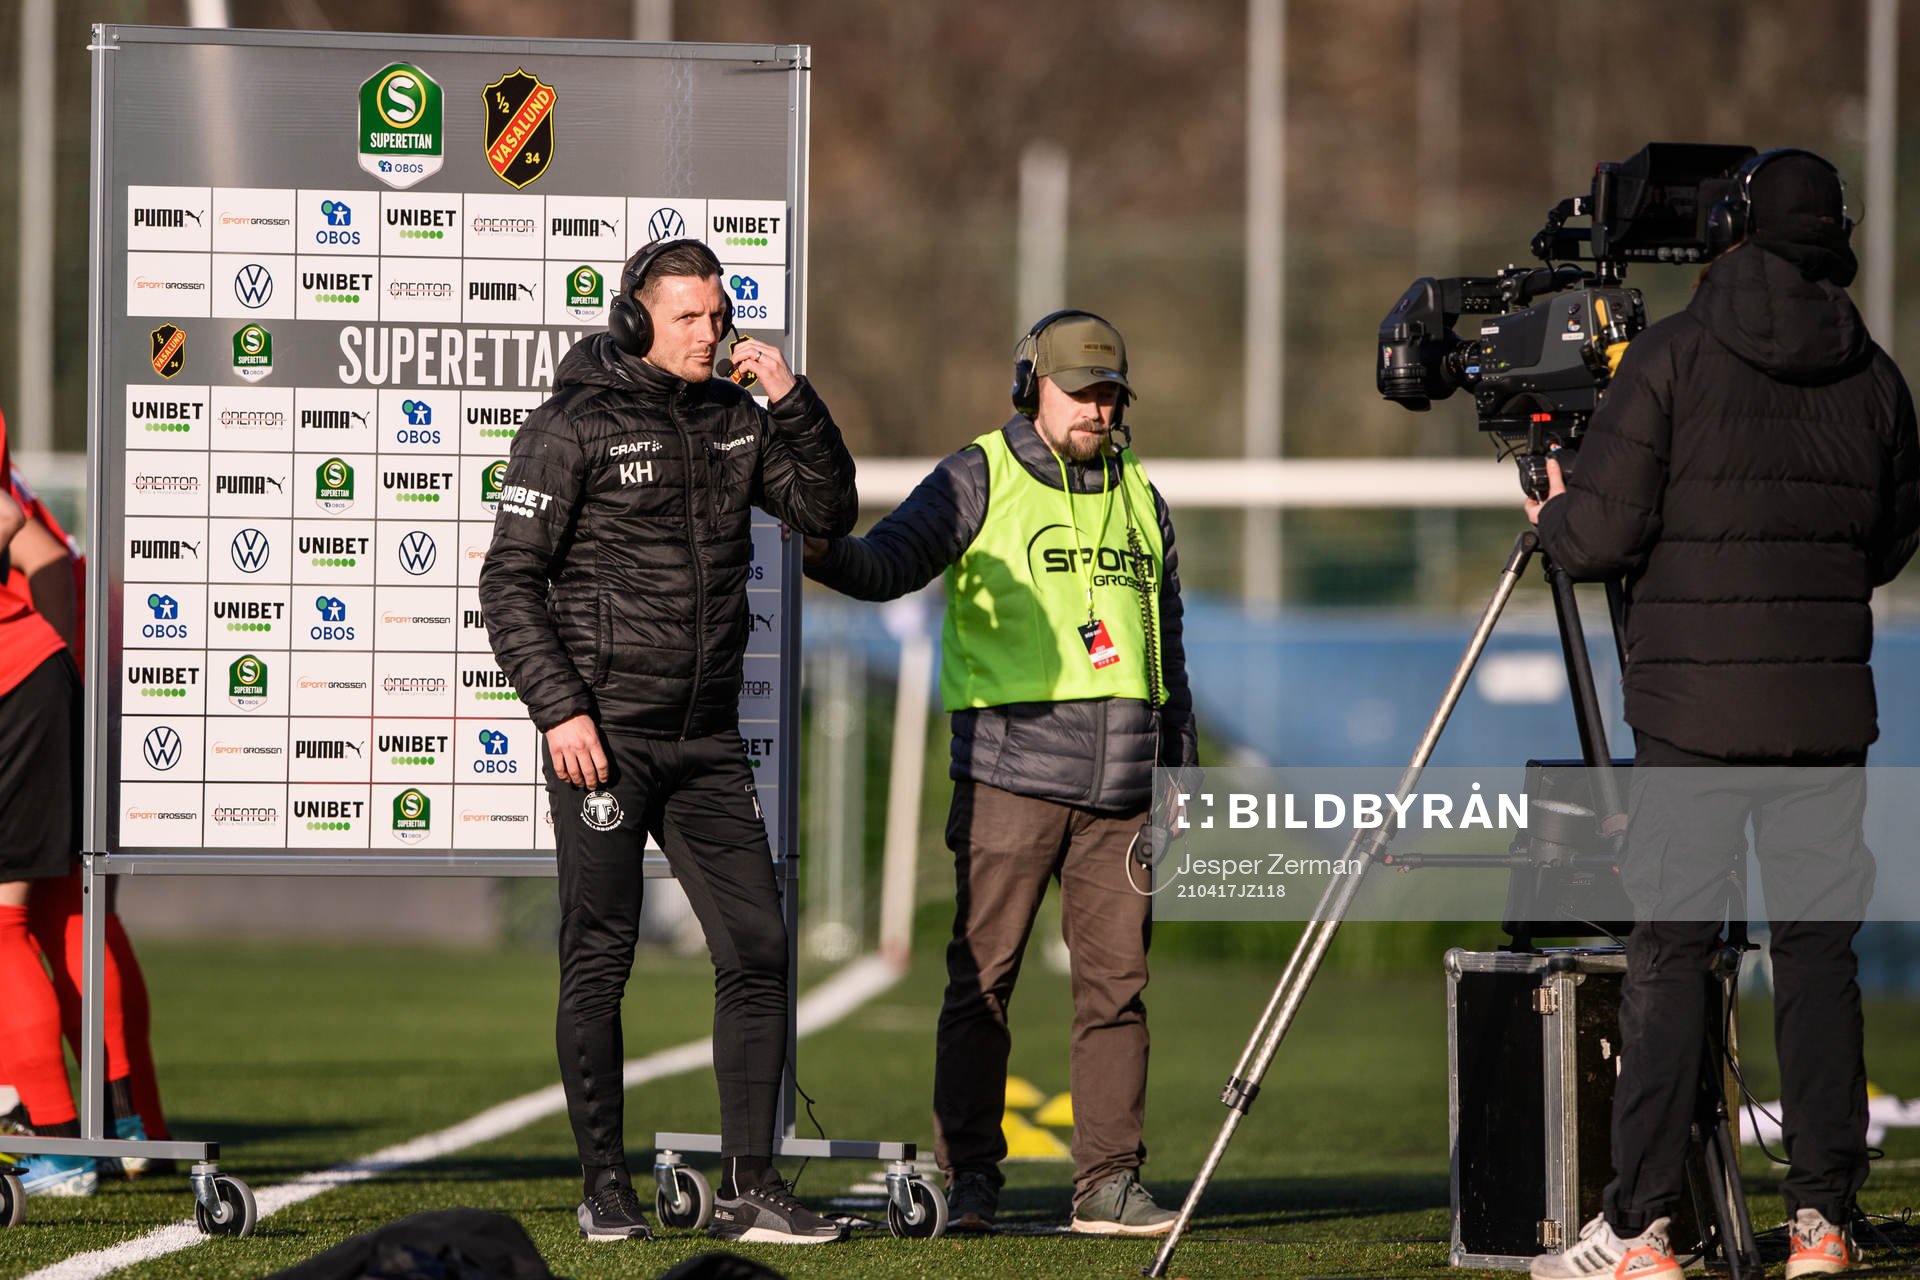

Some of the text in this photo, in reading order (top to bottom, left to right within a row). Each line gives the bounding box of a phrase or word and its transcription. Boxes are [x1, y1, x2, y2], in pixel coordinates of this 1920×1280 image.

[492, 90, 550, 165] VASALUND
[370, 133, 432, 149] SUPERETTAN
[525, 152, 540, 164] 34
[395, 164, 423, 173] OBOS
[134, 209, 183, 227] PUMA
[387, 209, 456, 226] UNIBET
[474, 218, 534, 232] CREATOR
[714, 217, 780, 233] UNIBET
[552, 218, 599, 236] PUMA
[316, 231, 360, 244] OBOS
[303, 273, 372, 290] UNIBET
[390, 283, 451, 296] CREATOR
[469, 282, 516, 300] PUMA
[571, 296, 599, 304] SUPERETTAN
[155, 332, 183, 368] VASALUND
[238, 356, 268, 364] SUPERETTAN
[133, 402, 203, 419] UNIBET
[222, 412, 283, 425] CREATOR
[302, 411, 349, 428] PUMA
[397, 430, 440, 444] OBOS
[610, 441, 651, 456] CRAFT
[384, 472, 452, 489] UNIBET
[620, 461, 653, 485] KH
[136, 476, 197, 490] CREATOR
[216, 476, 265, 494] PUMA
[321, 489, 349, 497] SUPERETTAN
[501, 485, 553, 511] UNIBET
[131, 540, 179, 559] PUMA
[299, 537, 369, 554] UNIBET
[214, 602, 284, 619] UNIBET
[464, 611, 484, 628] PU
[143, 625, 187, 638] OBOS
[311, 627, 354, 640] OBOS
[129, 667, 199, 684] UNIBET
[463, 671, 511, 687] UNIB
[234, 686, 263, 694] SUPERETTAN
[384, 678, 444, 691] CREATOR
[296, 741, 344, 758] PUMA
[379, 736, 448, 752] UNIBET
[742, 739, 773, 755] BET
[474, 760, 516, 773] OBOS
[215, 808, 276, 821] CREATOR
[294, 801, 363, 818] UNIBET
[398, 819, 426, 827] SUPERETTAN
